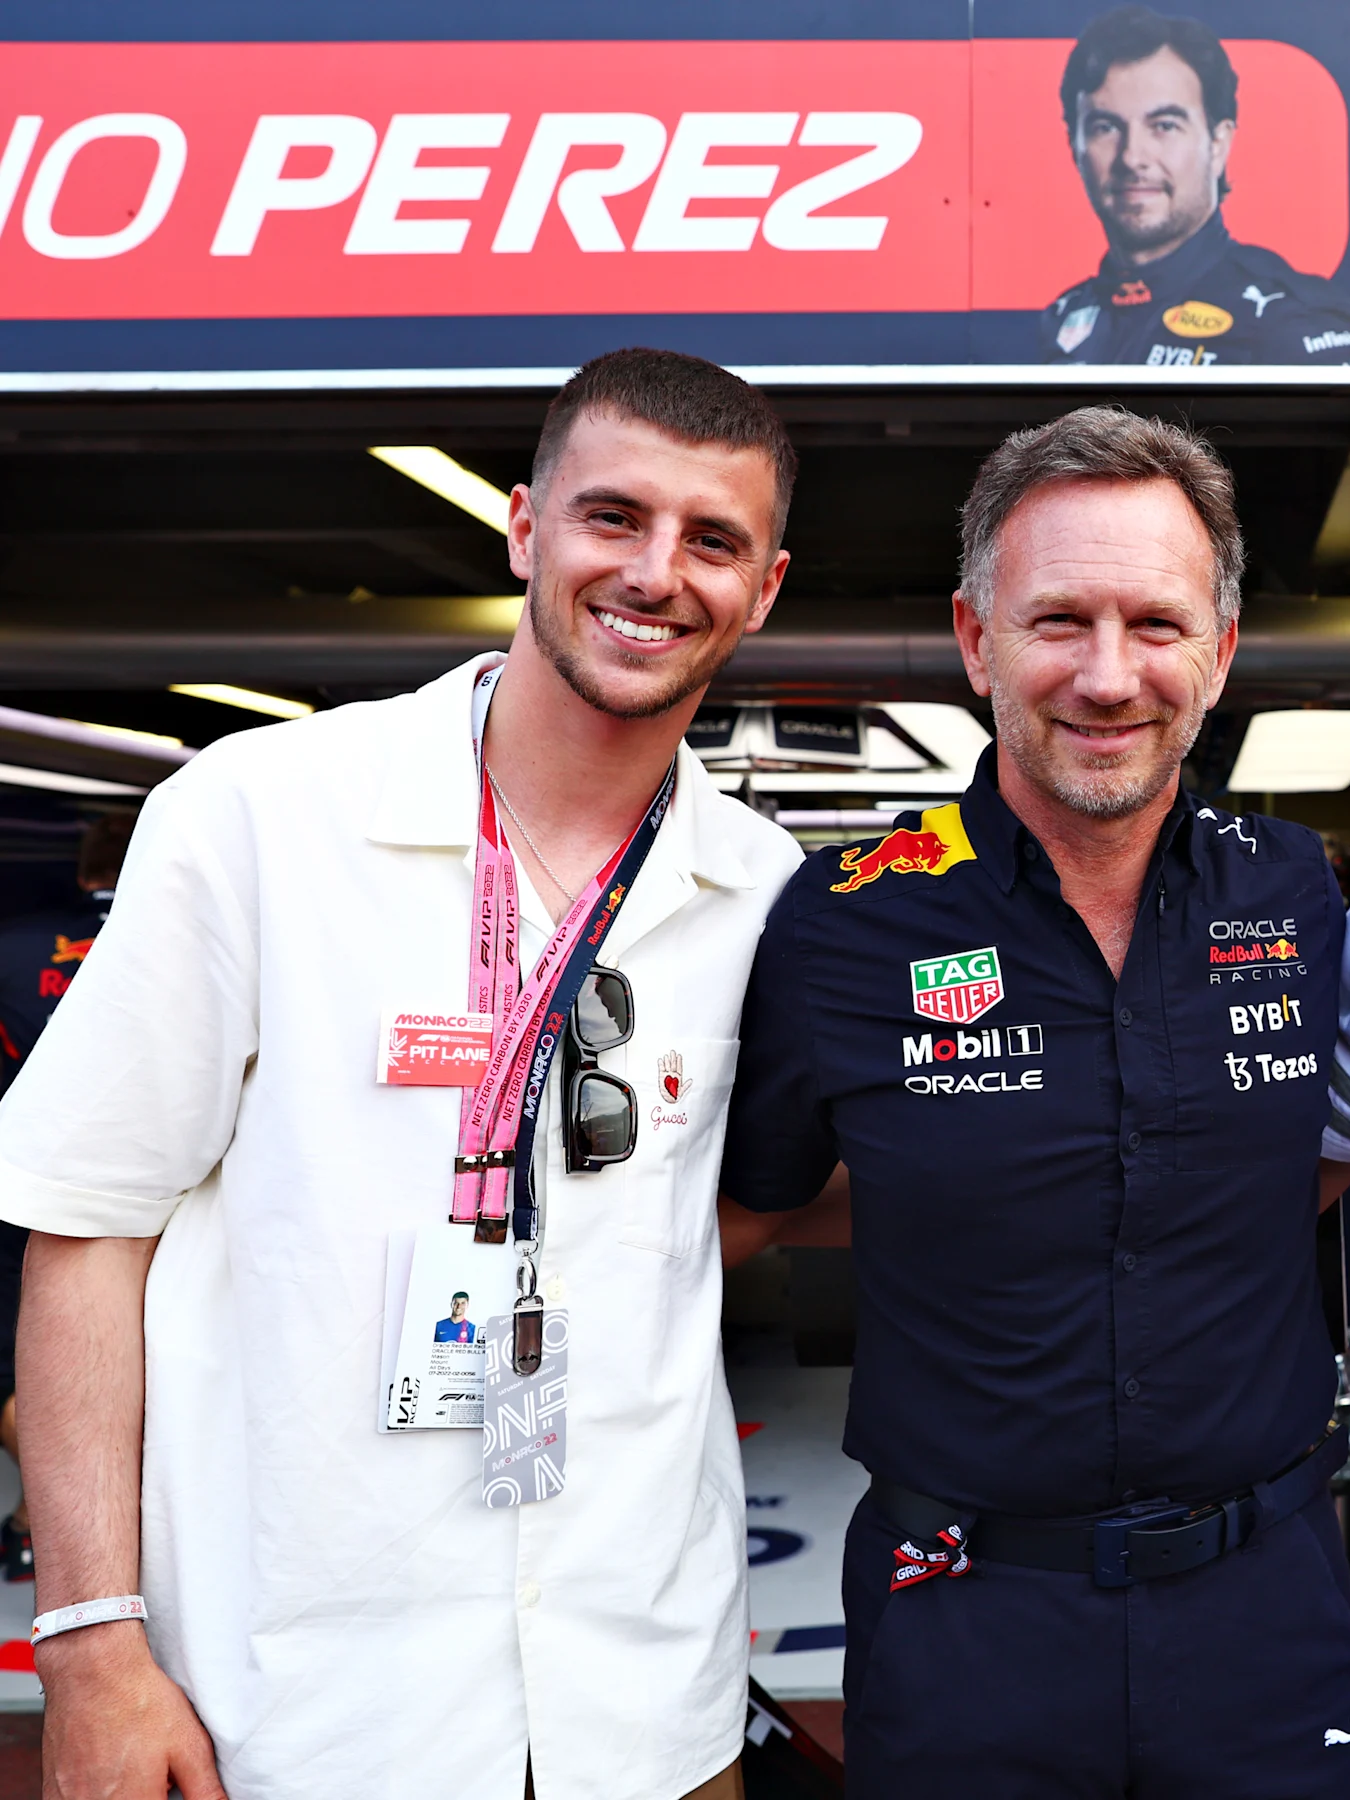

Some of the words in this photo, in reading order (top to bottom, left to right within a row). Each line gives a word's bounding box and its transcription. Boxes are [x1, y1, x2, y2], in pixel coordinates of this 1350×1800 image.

[210, 110, 923, 257] PEREZ
[1146, 344, 1218, 366] BYBIT
[485, 864, 495, 897] 2022
[504, 864, 512, 896] 2022
[482, 900, 492, 936] VIP
[506, 899, 515, 936] VIP
[550, 926, 567, 957] VIP
[566, 899, 586, 925] 2022
[1208, 918, 1297, 940] ORACLE
[918, 955, 993, 986] TAG
[1209, 964, 1308, 985] RACING
[479, 985, 489, 1014] ASTICS
[916, 982, 999, 1023] HEUER
[1229, 994, 1304, 1035] BYBIT
[528, 1013, 542, 1034] BY
[410, 1046, 438, 1060] PIT
[441, 1047, 490, 1061] LANE
[472, 1105, 486, 1127] NET
[480, 1078, 495, 1105] ZERO
[490, 1036, 513, 1078] CARBON
[507, 1020, 520, 1036] BY
[516, 992, 533, 1020] 2030
[516, 1034, 535, 1071] CARBON
[902, 1028, 1001, 1068] Mobil
[523, 1034, 555, 1119] MONACO
[545, 1011, 564, 1034] 22
[1255, 1052, 1319, 1084] Tezos
[508, 1072, 523, 1099] ZERO
[904, 1069, 1044, 1095] ORACLE
[502, 1100, 516, 1122] NET
[651, 1106, 688, 1131] Gucci
[497, 1380, 524, 1397] SATURDAY
[530, 1365, 556, 1381] SATURDAY
[397, 1376, 413, 1424] VIP
[409, 1378, 421, 1424] ACCESS
[492, 1441, 542, 1473] MONACO
[543, 1432, 558, 1447] 22
[130, 1601, 142, 1614] 22
